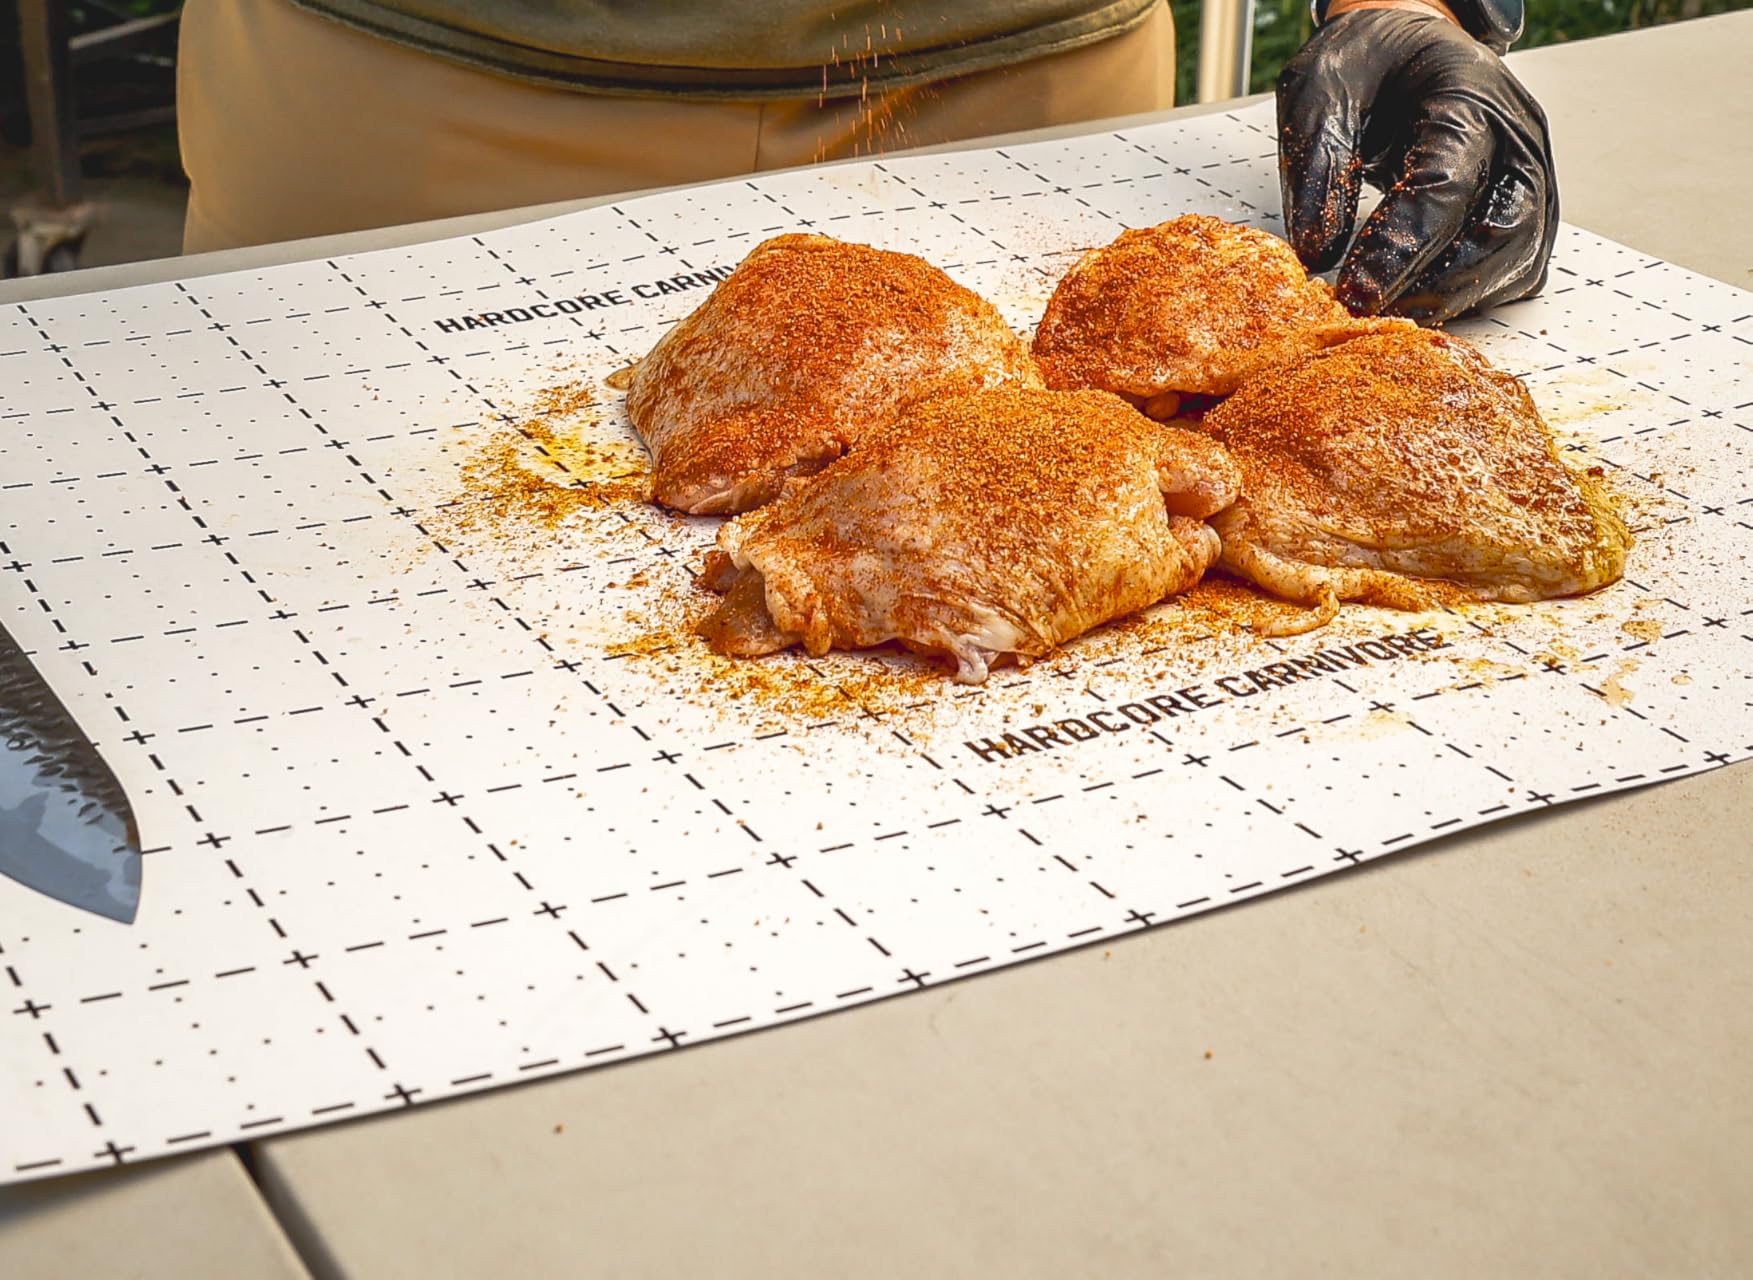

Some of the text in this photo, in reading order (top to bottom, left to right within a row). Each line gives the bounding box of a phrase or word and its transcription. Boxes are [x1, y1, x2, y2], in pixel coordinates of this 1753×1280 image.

[433, 289, 632, 333] HARDCORE
[963, 627, 1454, 763] HARDCORE CARNIVORE
